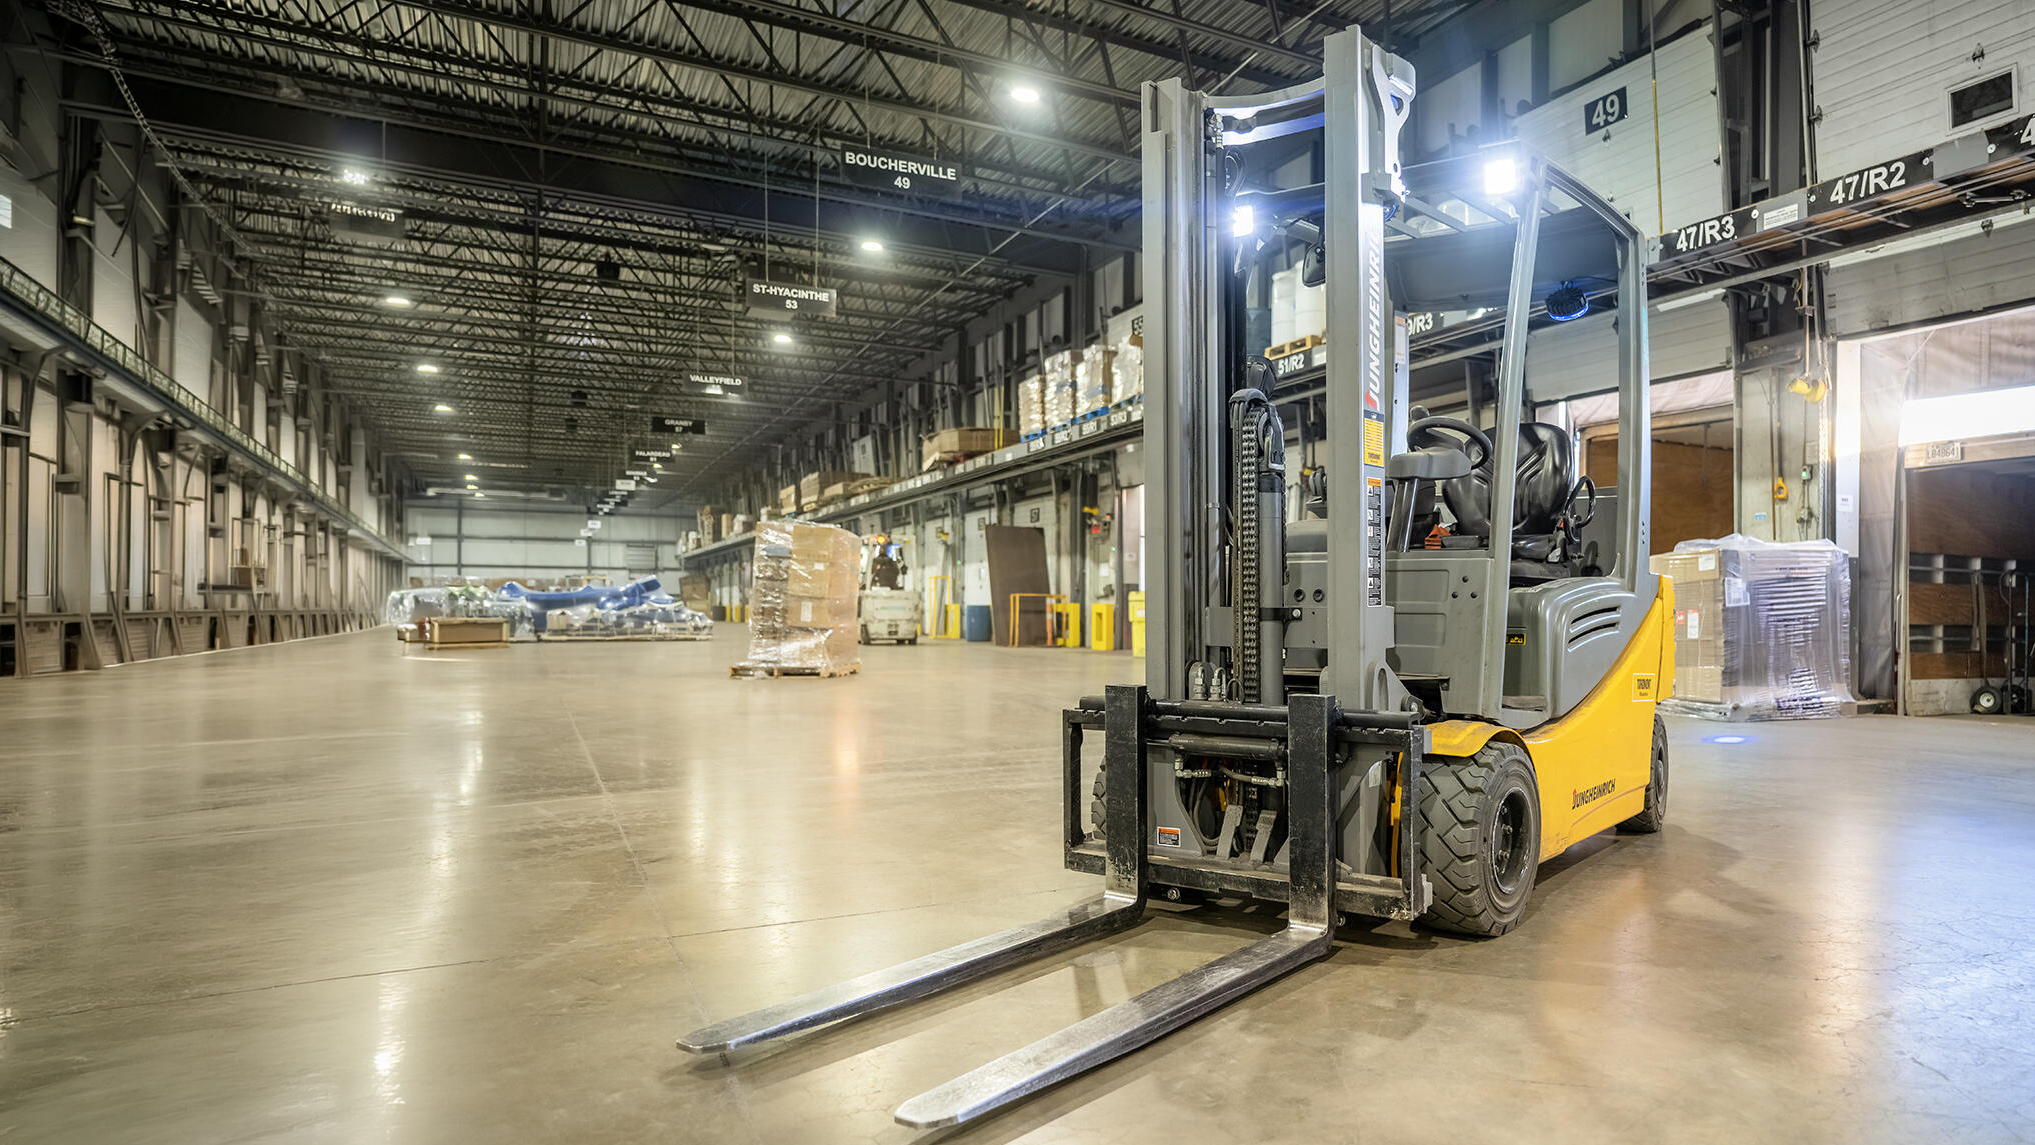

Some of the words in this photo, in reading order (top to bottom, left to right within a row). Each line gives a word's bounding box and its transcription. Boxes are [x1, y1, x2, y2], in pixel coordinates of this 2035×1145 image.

[1592, 94, 1620, 127] 49
[2020, 116, 2035, 146] 4
[845, 151, 957, 180] BOUCHERVILLE
[893, 176, 911, 189] 49
[1830, 161, 1907, 204] 47/R2
[1676, 215, 1736, 252] 47/R3
[752, 283, 830, 302] ST-HYACINTHE
[785, 299, 798, 309] 53
[1365, 224, 1380, 411] JUNGHEINRI
[1408, 312, 1433, 336] 9/R3
[1278, 353, 1305, 375] 51/R2
[689, 374, 742, 386] VALLEYFIELD
[1571, 778, 1616, 810] JUNGHEINRICH
